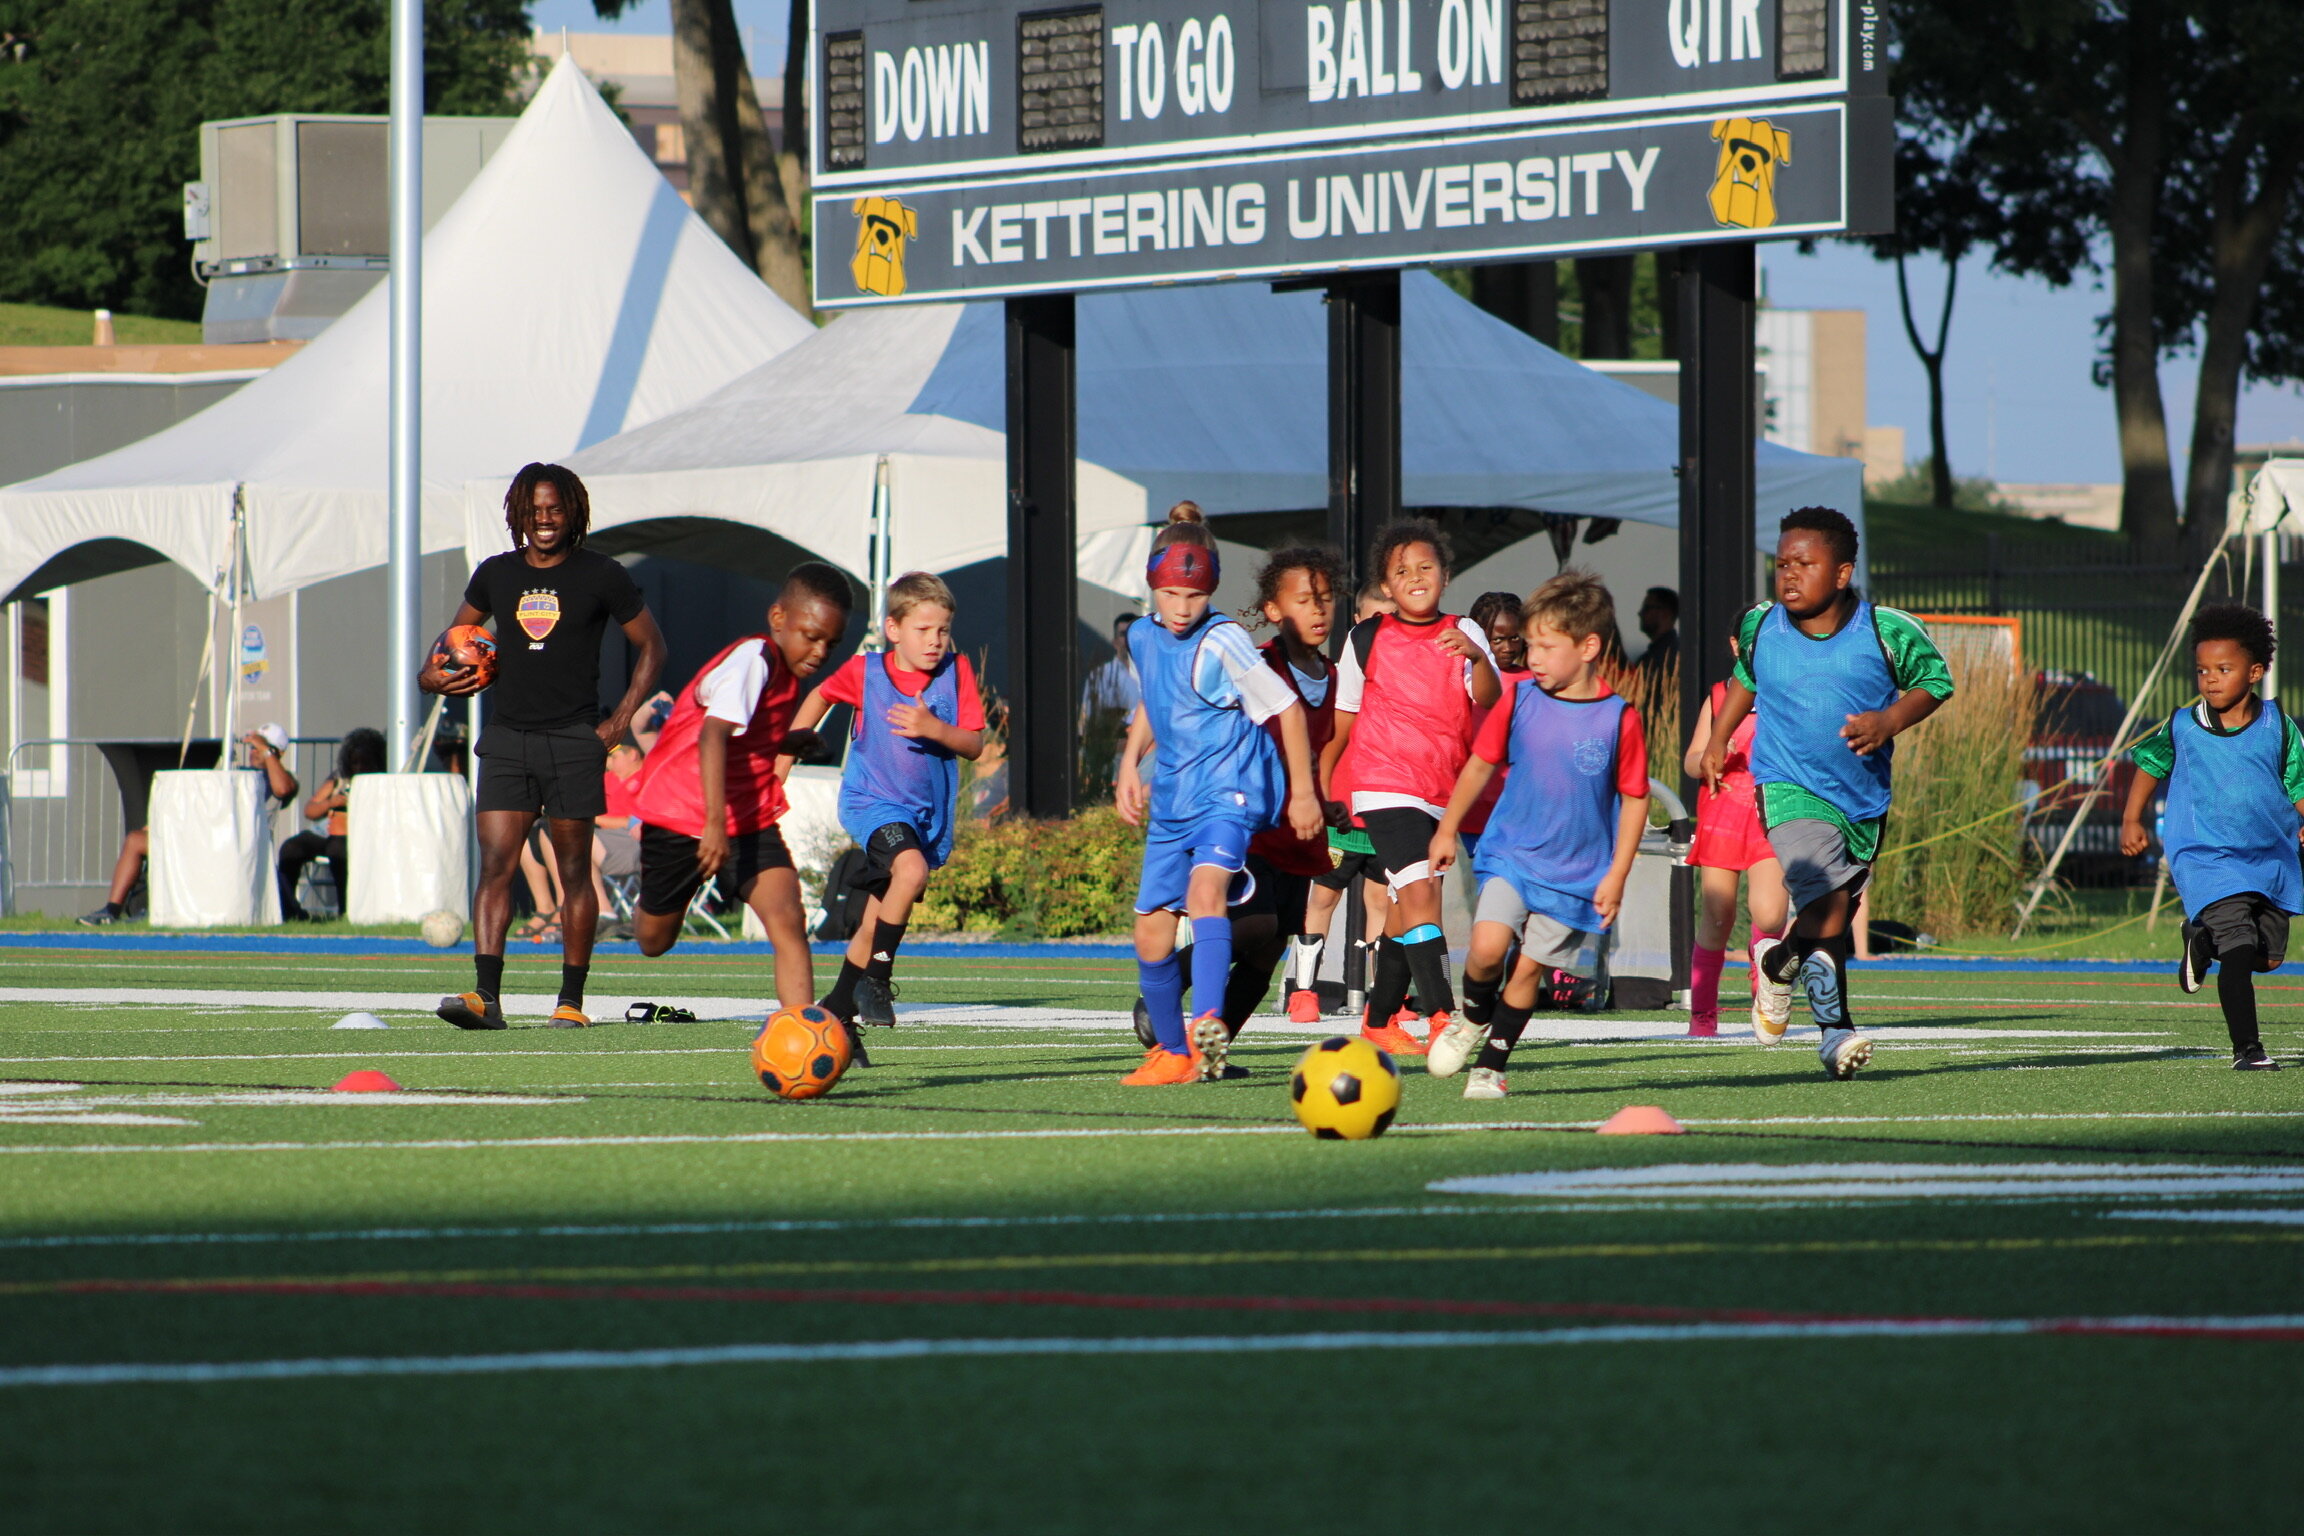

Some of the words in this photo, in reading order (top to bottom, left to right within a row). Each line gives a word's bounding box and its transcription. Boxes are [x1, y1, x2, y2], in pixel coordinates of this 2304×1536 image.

[1111, 21, 1166, 121] TO
[1174, 14, 1235, 116] GO
[1307, 0, 1423, 102] BALL
[1437, 0, 1502, 90] ON
[1668, 0, 1762, 68] QTR
[874, 40, 989, 144] DOWN
[952, 182, 1266, 267] KETTERING
[1288, 147, 1661, 239] UNIVERSITY
